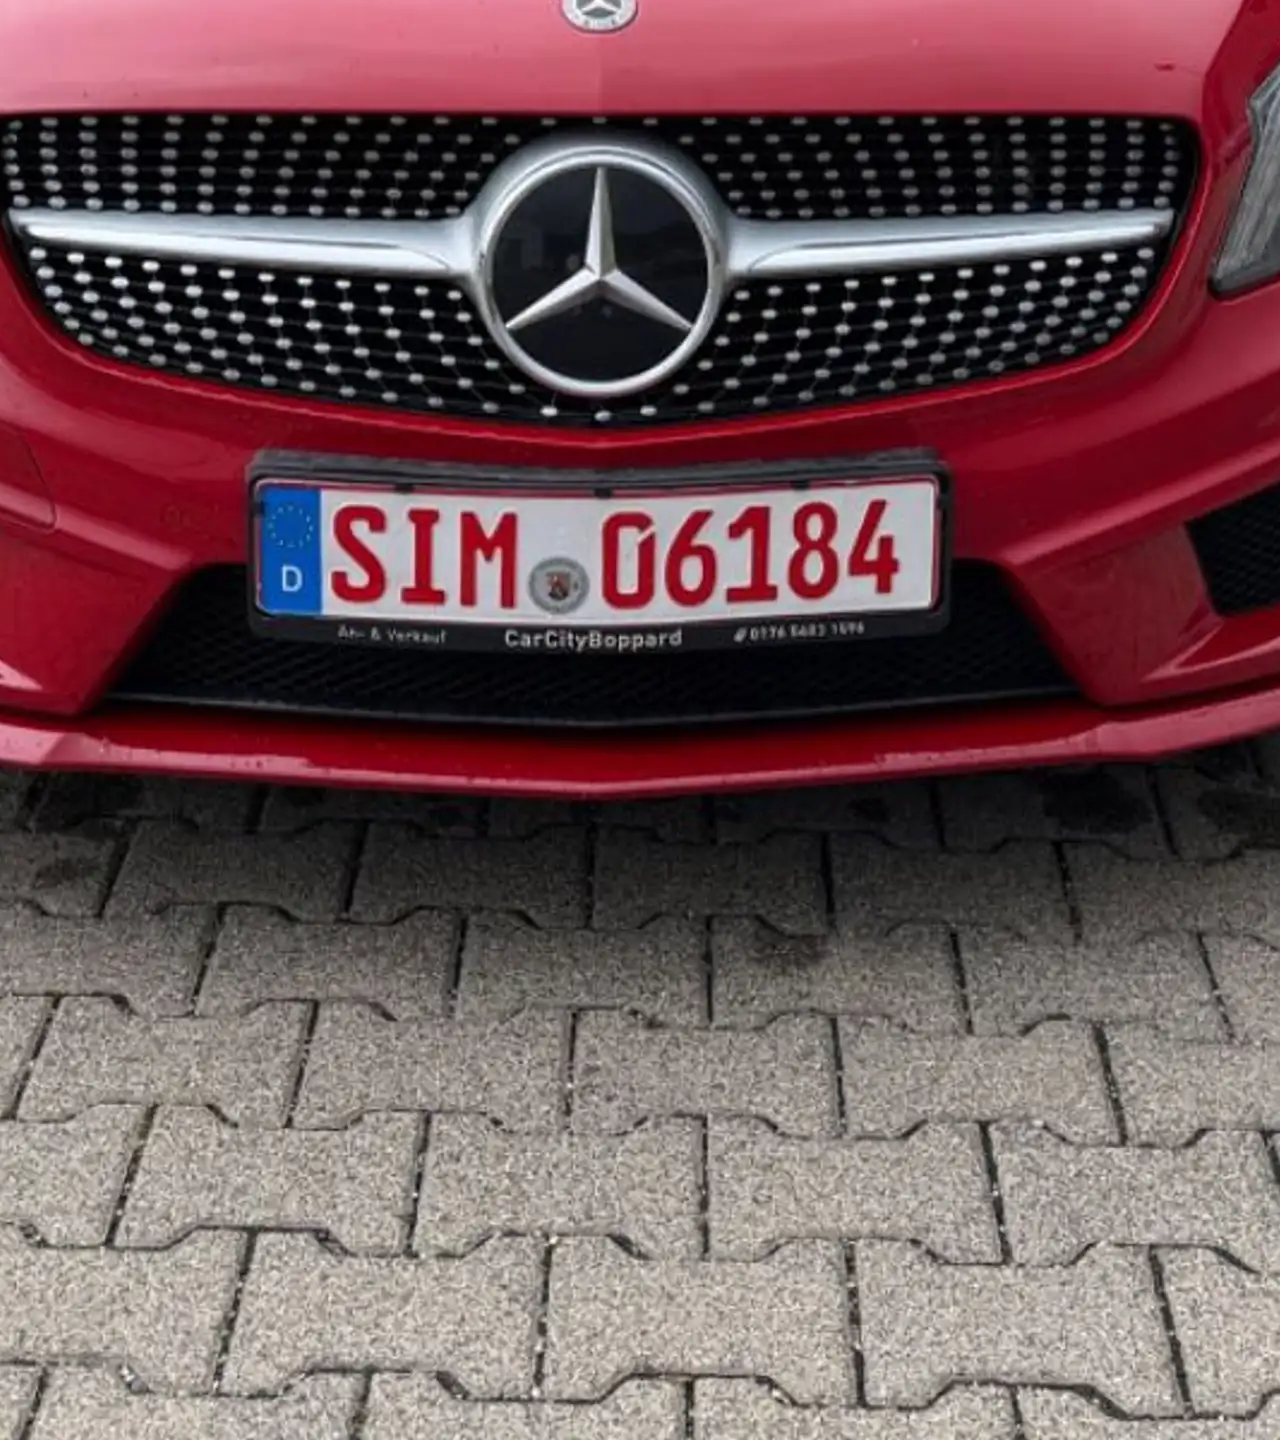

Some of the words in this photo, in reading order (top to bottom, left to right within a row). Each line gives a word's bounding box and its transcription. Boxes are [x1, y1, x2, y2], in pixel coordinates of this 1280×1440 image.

[330, 505, 517, 609] SIM
[601, 498, 901, 610] 06184
[282, 564, 303, 592] D
[504, 628, 683, 653] CarCityBoppard
